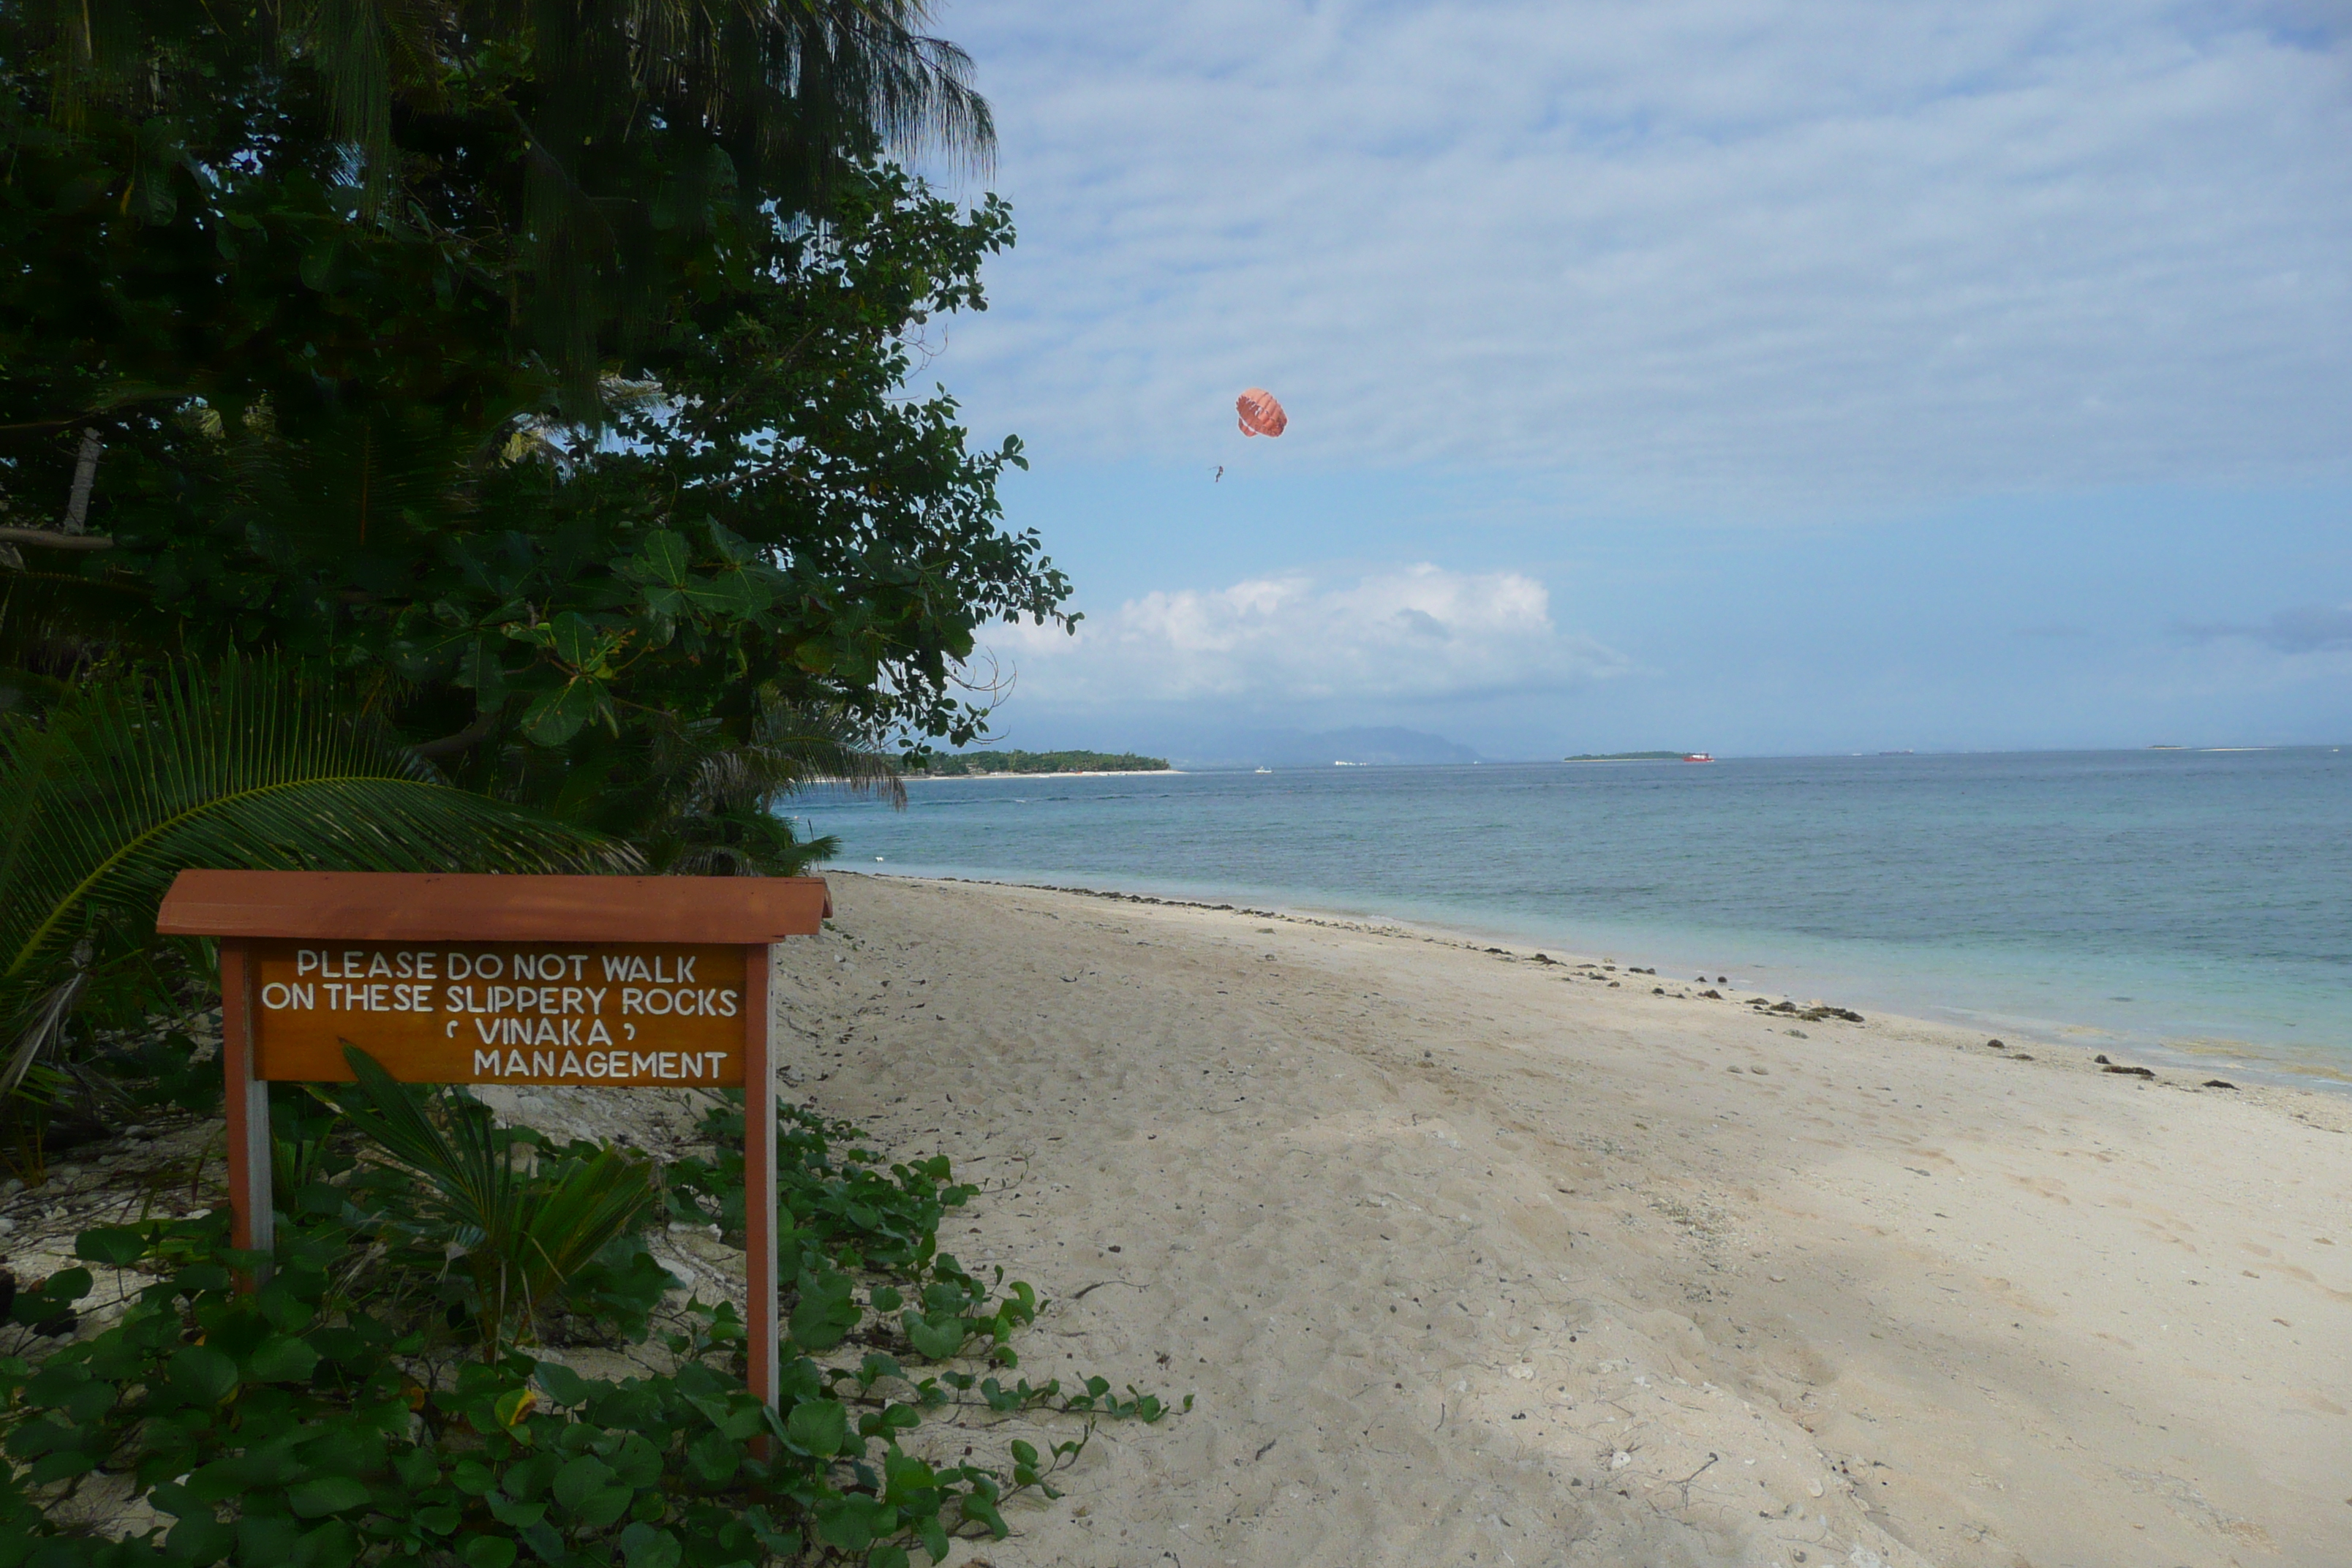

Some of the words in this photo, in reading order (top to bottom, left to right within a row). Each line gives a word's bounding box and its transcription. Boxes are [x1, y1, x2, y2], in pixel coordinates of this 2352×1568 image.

[297, 949, 437, 979] PLEASE
[448, 953, 503, 981] DO
[513, 954, 588, 981] NOT
[602, 955, 696, 983] WALK
[261, 981, 314, 1010] ON
[323, 983, 434, 1012] THESE
[445, 985, 607, 1014] SLIPPERY
[622, 987, 738, 1017] ROCKS
[474, 1049, 727, 1079] MANAGEMENT
